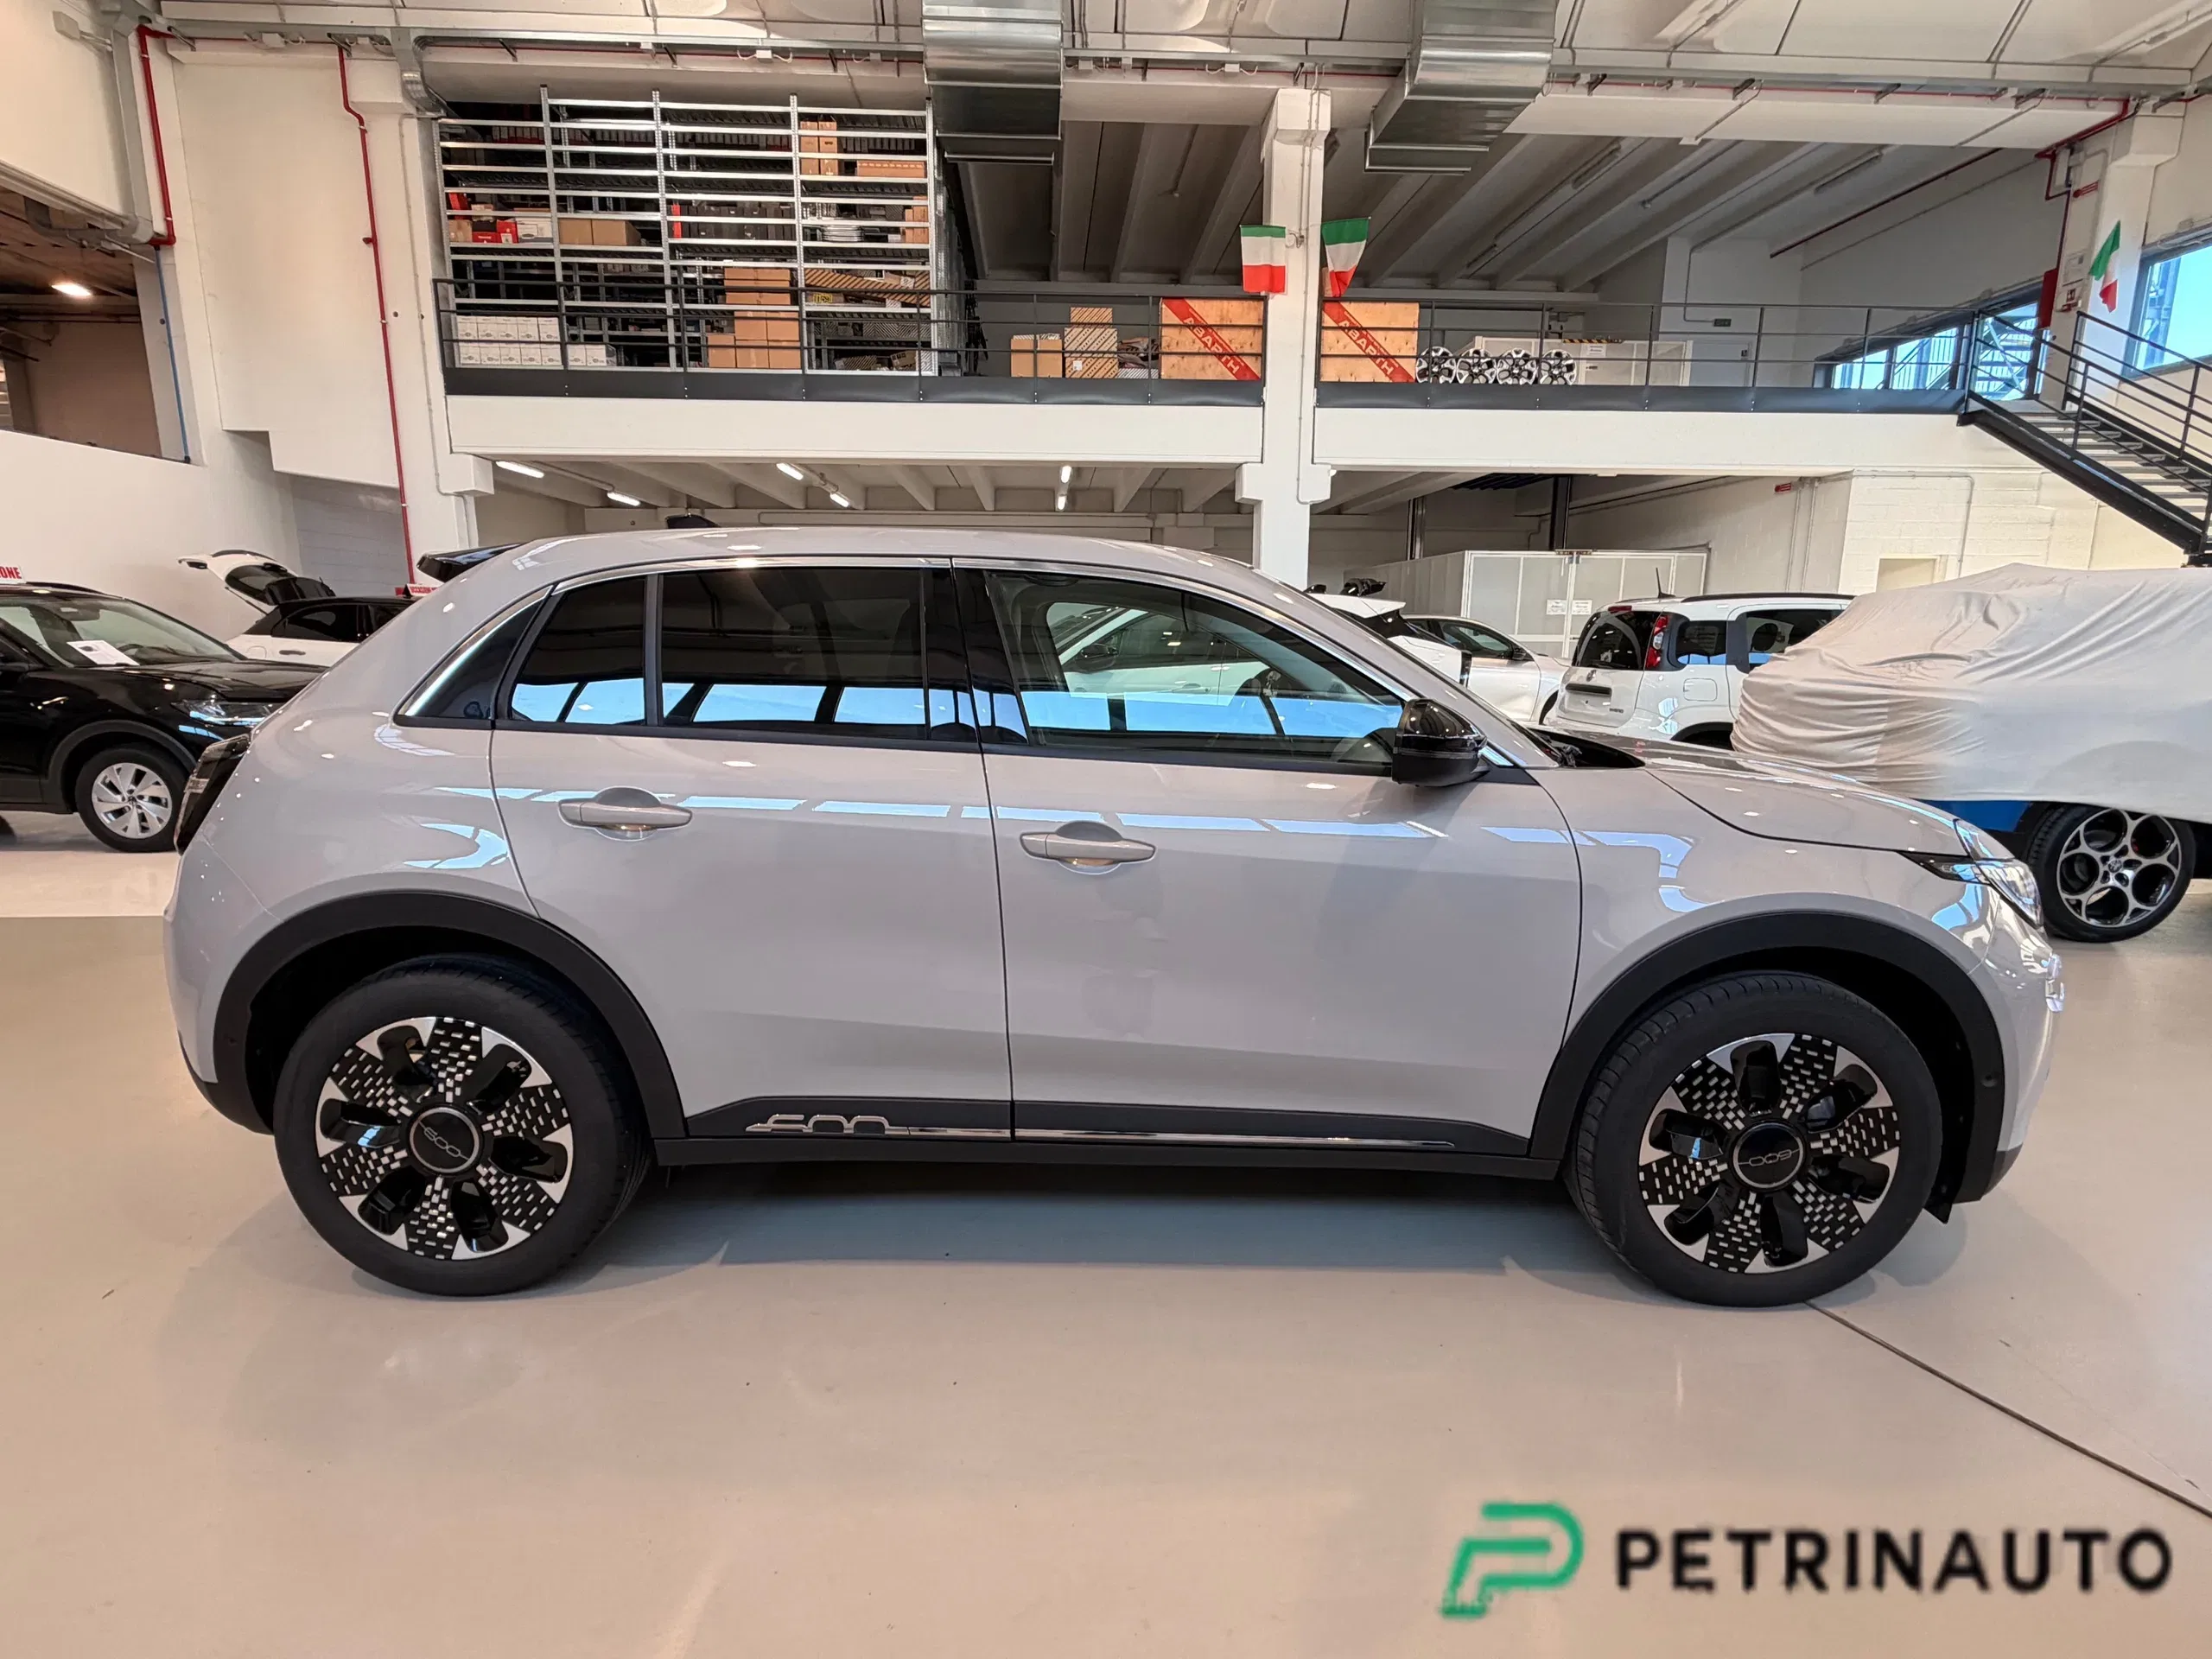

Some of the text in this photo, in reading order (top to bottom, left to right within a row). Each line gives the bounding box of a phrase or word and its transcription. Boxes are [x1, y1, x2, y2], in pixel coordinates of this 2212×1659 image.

[1184, 317, 1239, 373] ABARTH
[1338, 320, 1394, 374] ABARTH
[0, 566, 22, 579] ONE
[424, 1127, 461, 1157] 600
[1749, 1149, 1792, 1166] 600
